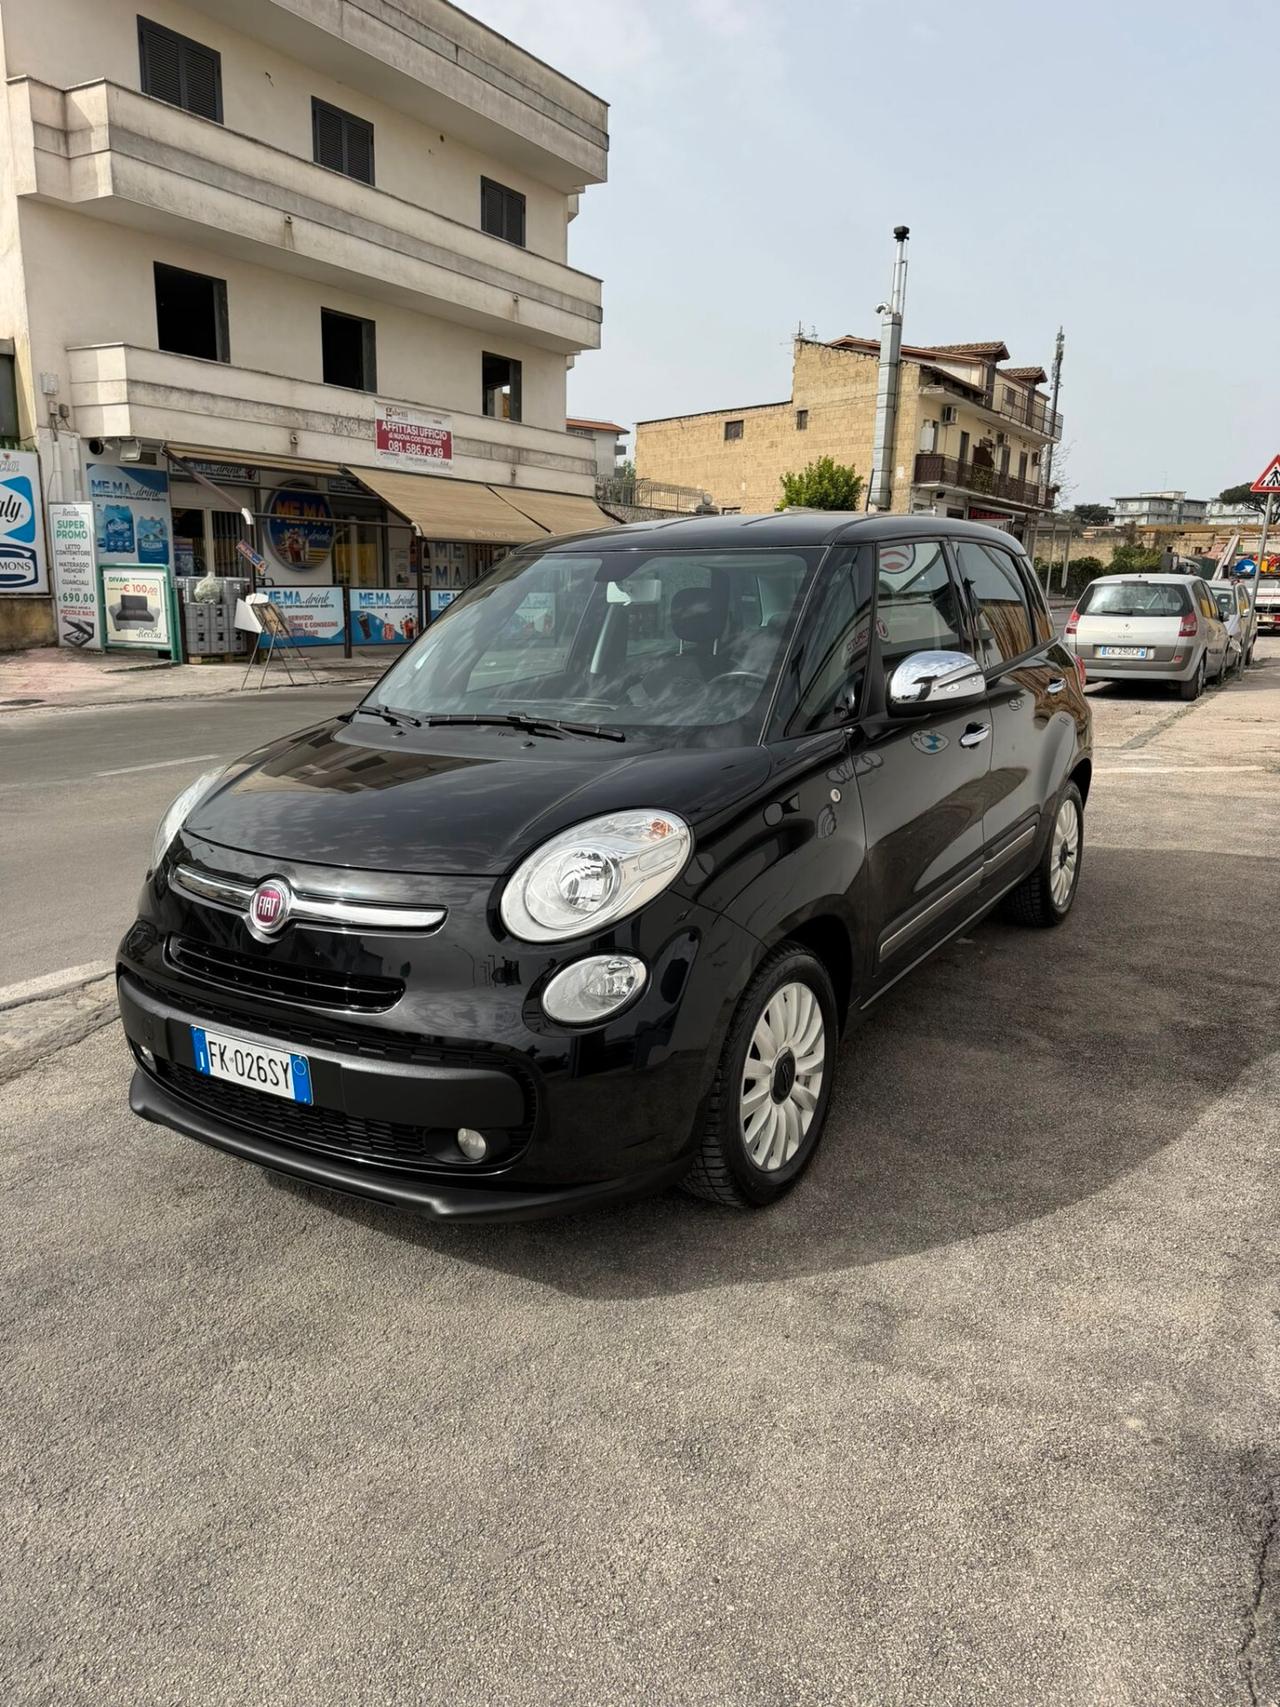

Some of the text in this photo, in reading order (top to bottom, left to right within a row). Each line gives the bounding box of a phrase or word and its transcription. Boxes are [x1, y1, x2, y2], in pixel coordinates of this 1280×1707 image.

[382, 421, 419, 435] AFFITTASI
[420, 428, 448, 440] UFFICIO
[57, 519, 85, 529] SUPER
[56, 530, 88, 540] PROMO
[58, 561, 90, 569] MATERASSO
[63, 592, 95, 603] 690,00
[60, 608, 80, 616] PICCOLE
[257, 895, 278, 918] FIAT
